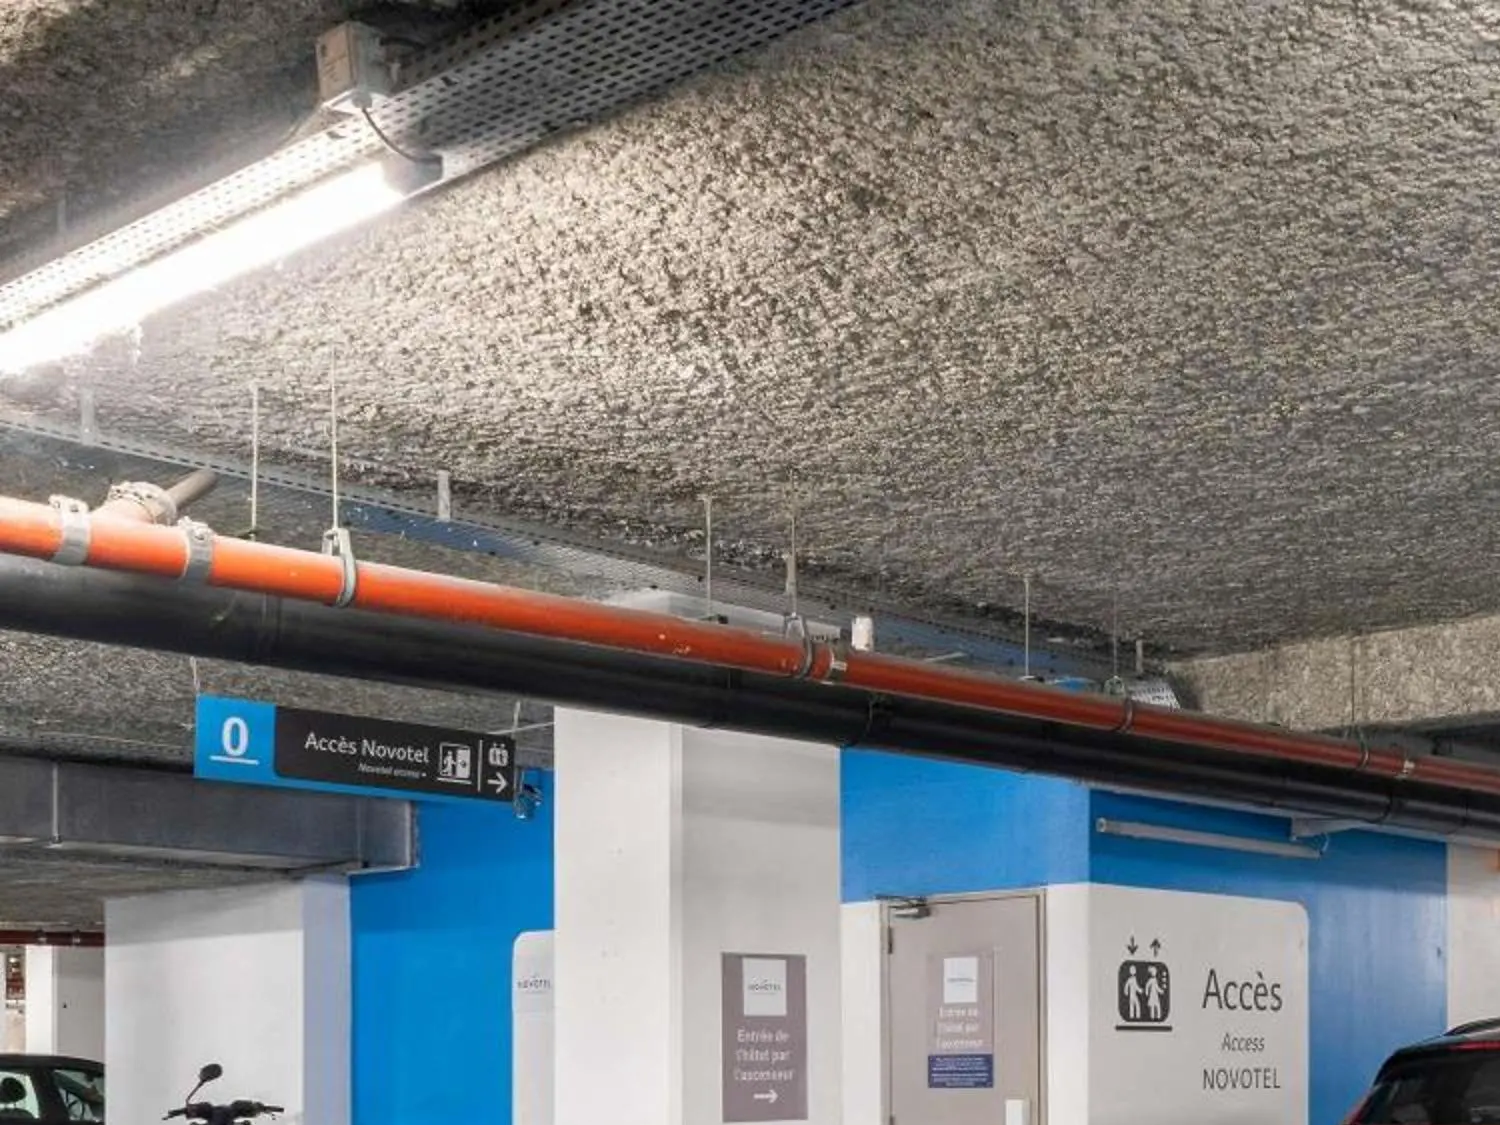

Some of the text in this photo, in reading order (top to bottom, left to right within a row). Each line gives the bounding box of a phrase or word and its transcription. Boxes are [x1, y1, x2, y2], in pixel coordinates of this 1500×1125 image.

[221, 716, 249, 757] 0
[304, 731, 430, 763] Accès Novotel
[1202, 968, 1283, 1012] Accès
[1221, 1032, 1265, 1052] Access
[1203, 1067, 1281, 1090] NOVOTEL
